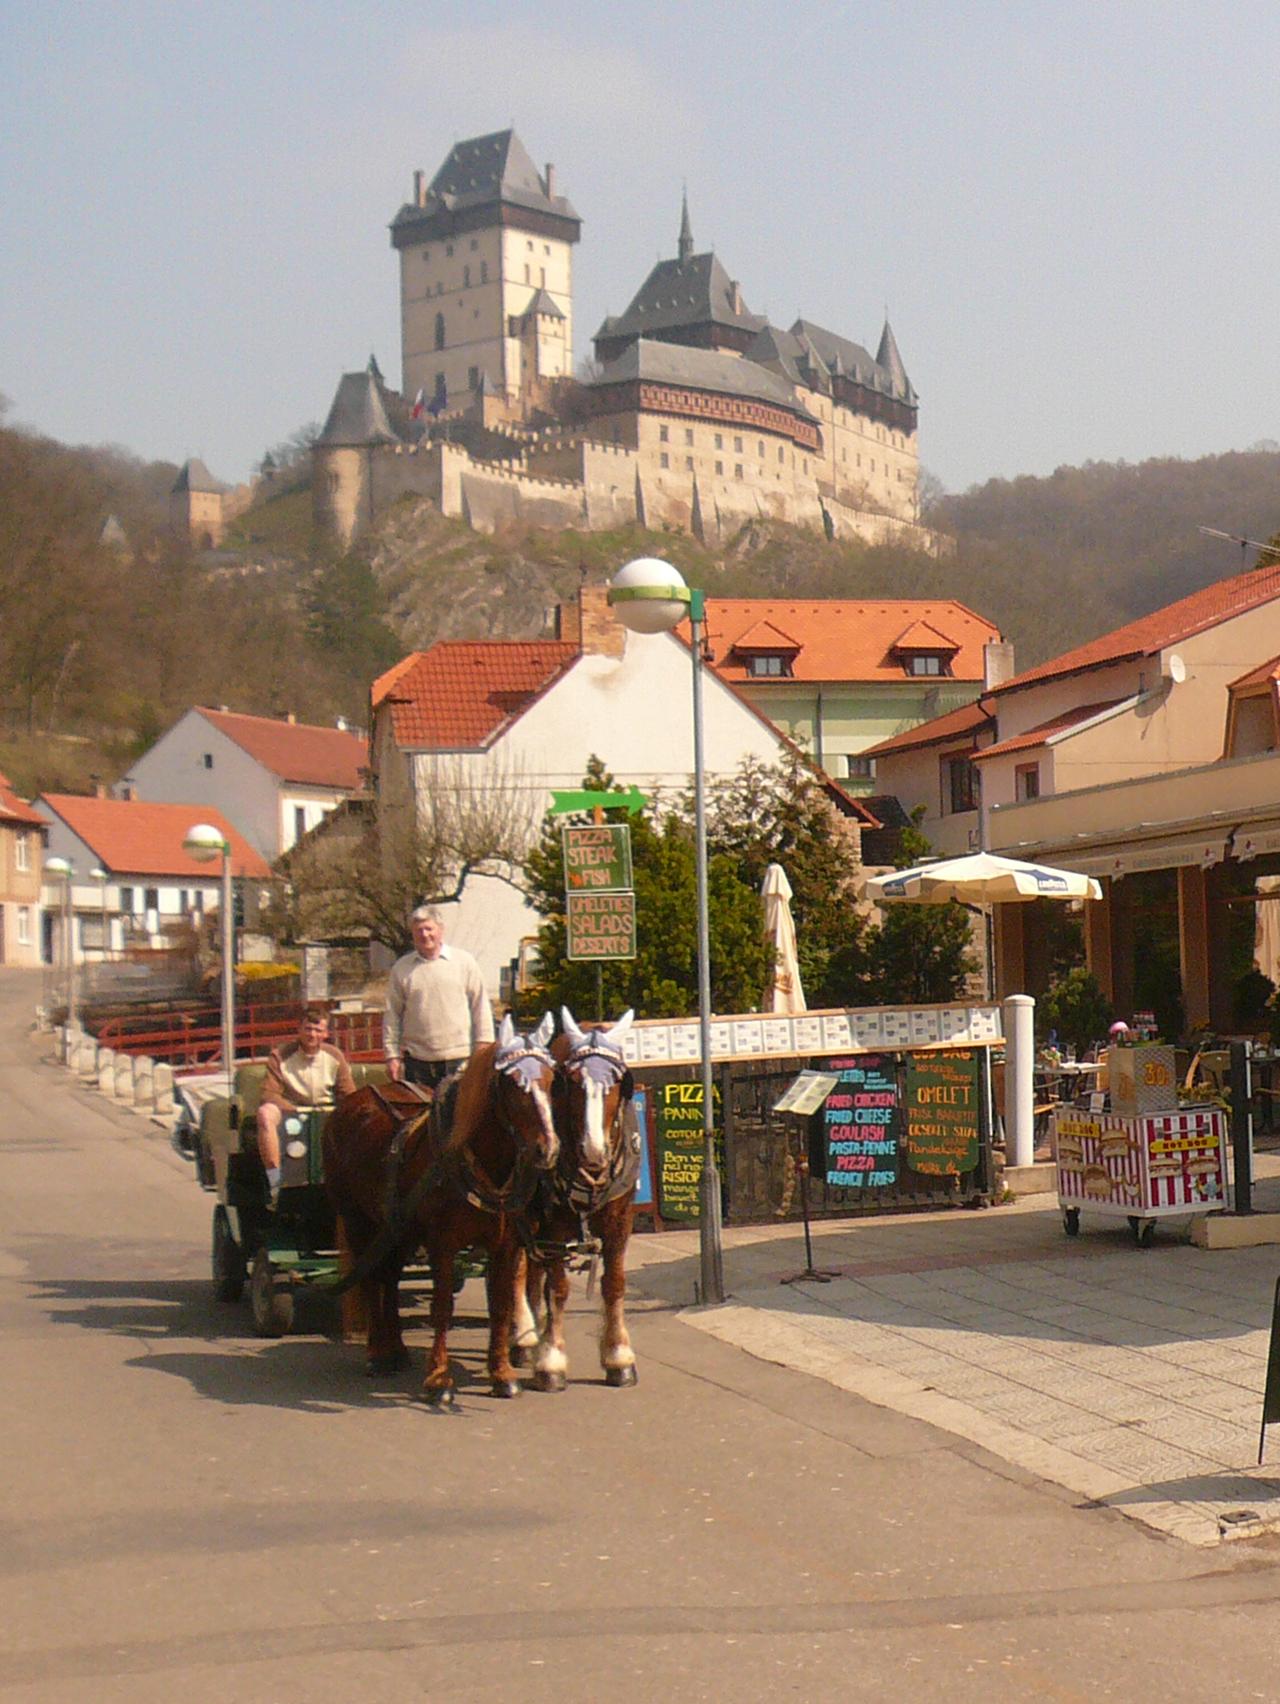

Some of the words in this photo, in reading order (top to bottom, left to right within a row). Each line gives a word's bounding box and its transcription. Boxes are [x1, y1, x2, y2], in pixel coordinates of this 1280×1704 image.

[569, 829, 612, 847] PIZZA
[568, 846, 618, 866] STEAK
[582, 869, 612, 886] FISH
[572, 913, 634, 935] SALADS
[917, 1086, 971, 1105] OMELET
[825, 1109, 853, 1124] FRIED
[830, 1125, 886, 1140] GOULASH
[836, 1155, 876, 1170] PIZZA
[867, 1171, 896, 1186] FRIES
